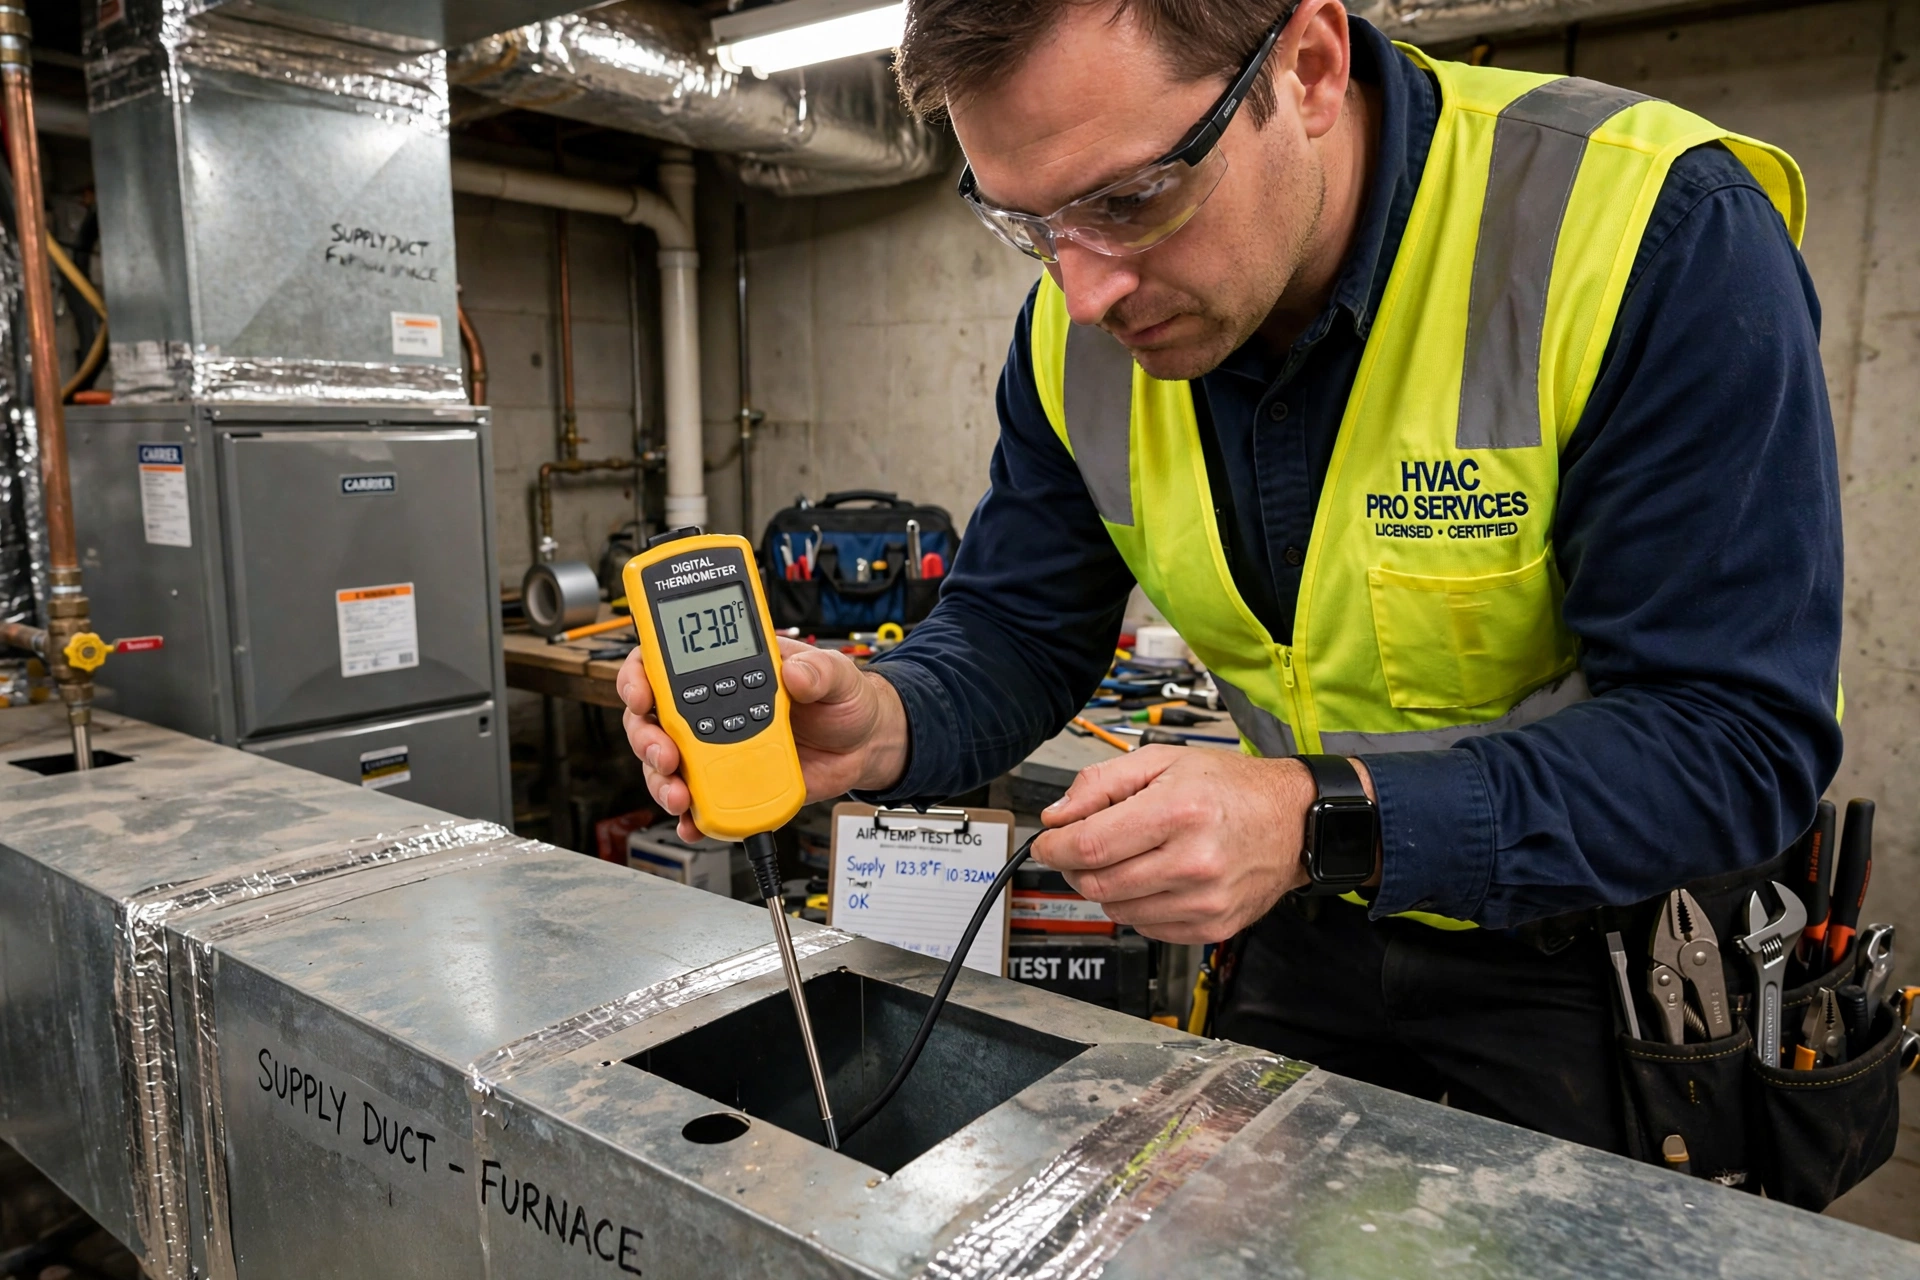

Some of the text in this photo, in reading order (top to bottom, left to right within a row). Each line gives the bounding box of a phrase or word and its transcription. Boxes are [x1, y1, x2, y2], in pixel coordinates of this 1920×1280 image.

[1401, 458, 1480, 492] HVAC
[1366, 491, 1529, 520] PRO SERVICES
[1375, 522, 1518, 539] LICENSED CERTIFIED
[655, 564, 737, 591] THERMOMETER
[671, 556, 714, 574] DIGITAL
[856, 828, 982, 846] AIR TEMP TEST LOG
[847, 855, 996, 884] Supply 123.8°F 10:32AM
[848, 894, 869, 909] OK
[1008, 956, 1105, 980] TEST KIT
[258, 1048, 347, 1135] SUPPLY
[362, 1101, 436, 1173] DUCT
[481, 1159, 644, 1277] FURNACE
